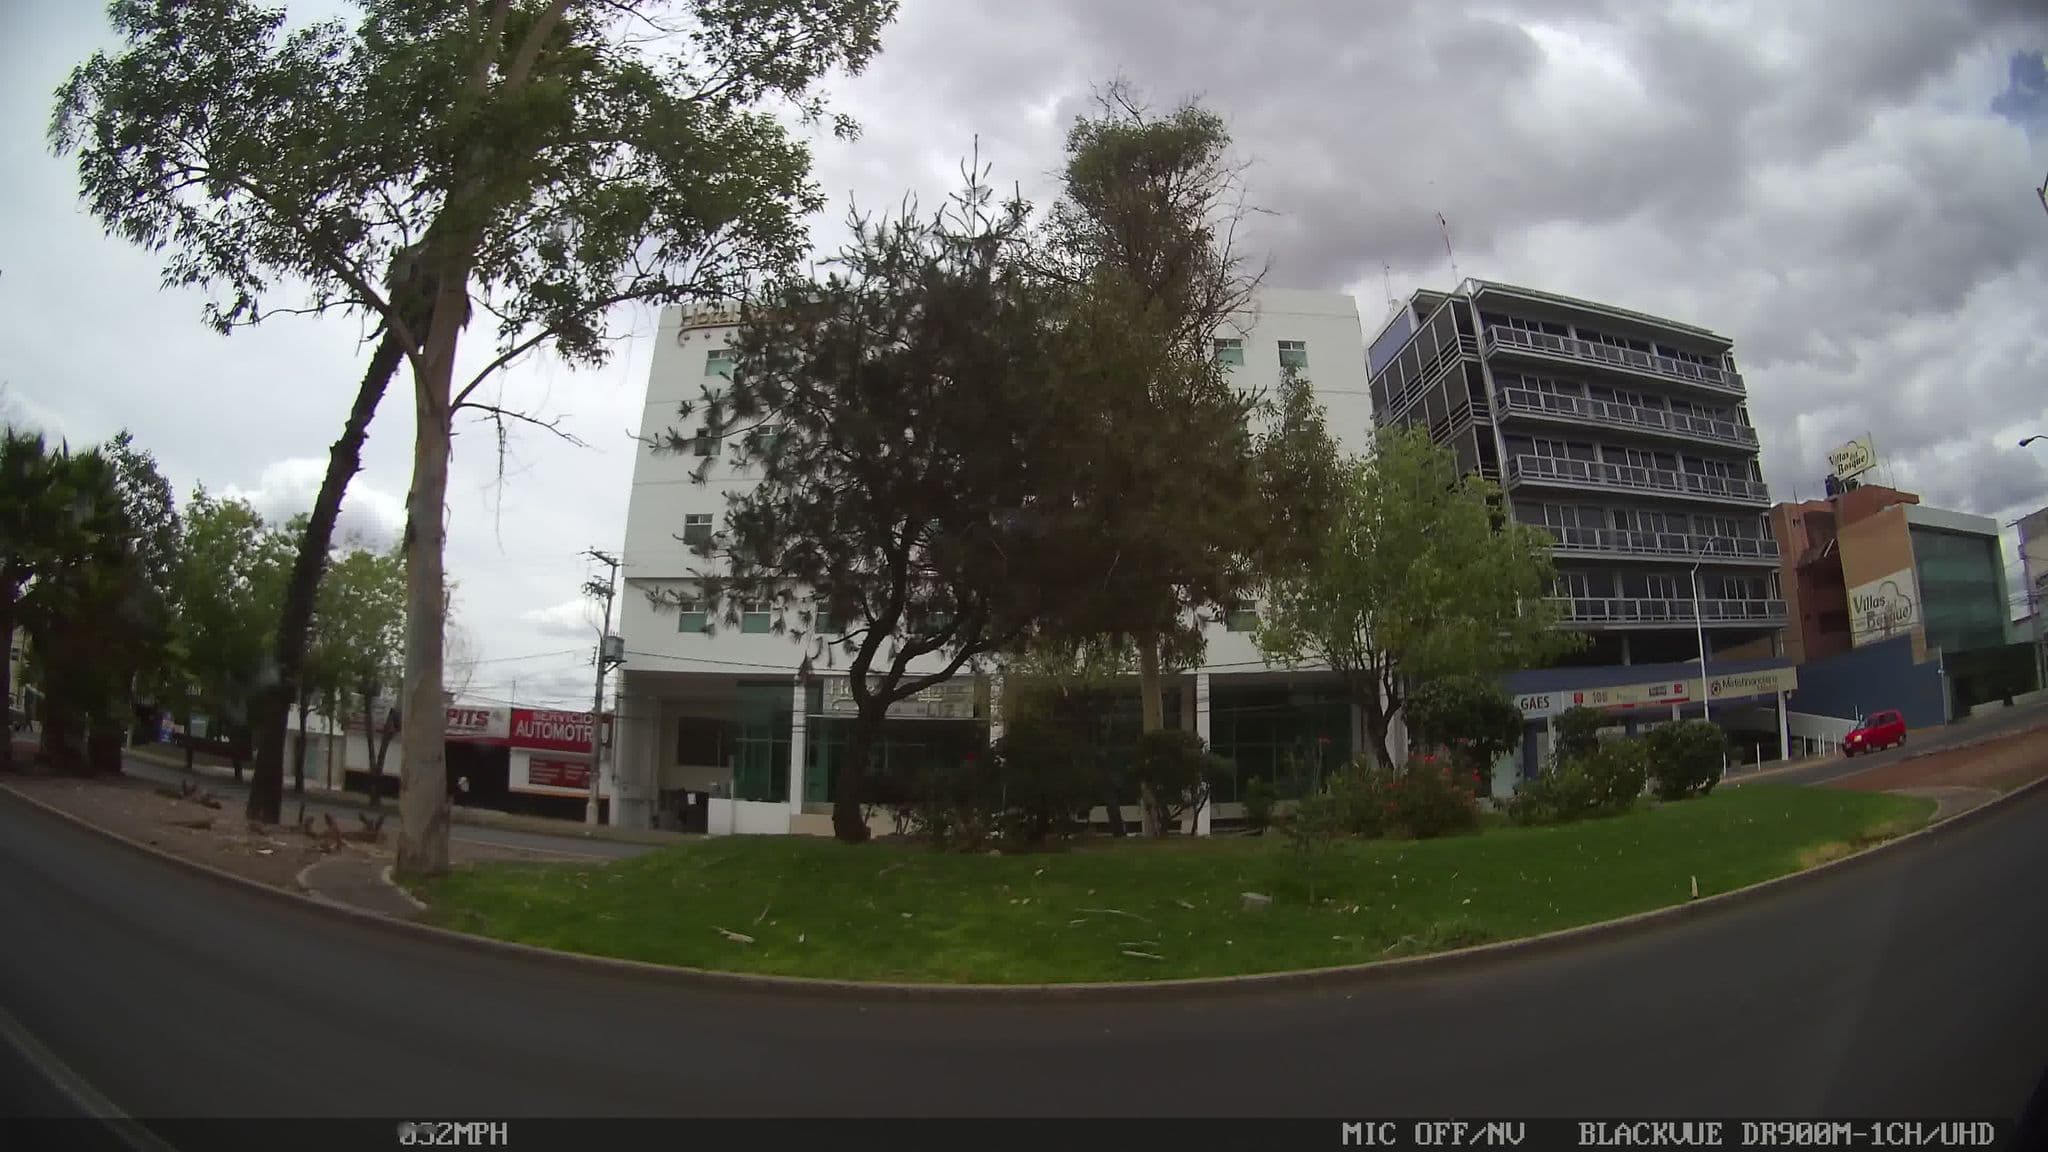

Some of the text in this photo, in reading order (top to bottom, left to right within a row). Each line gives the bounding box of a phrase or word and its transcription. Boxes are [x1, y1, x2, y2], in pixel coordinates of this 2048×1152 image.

[1838, 455, 1866, 475] Bosque
[1853, 595, 1885, 614] Villas
[1520, 695, 1550, 711] GAES
[533, 711, 594, 724] SERVICIO
